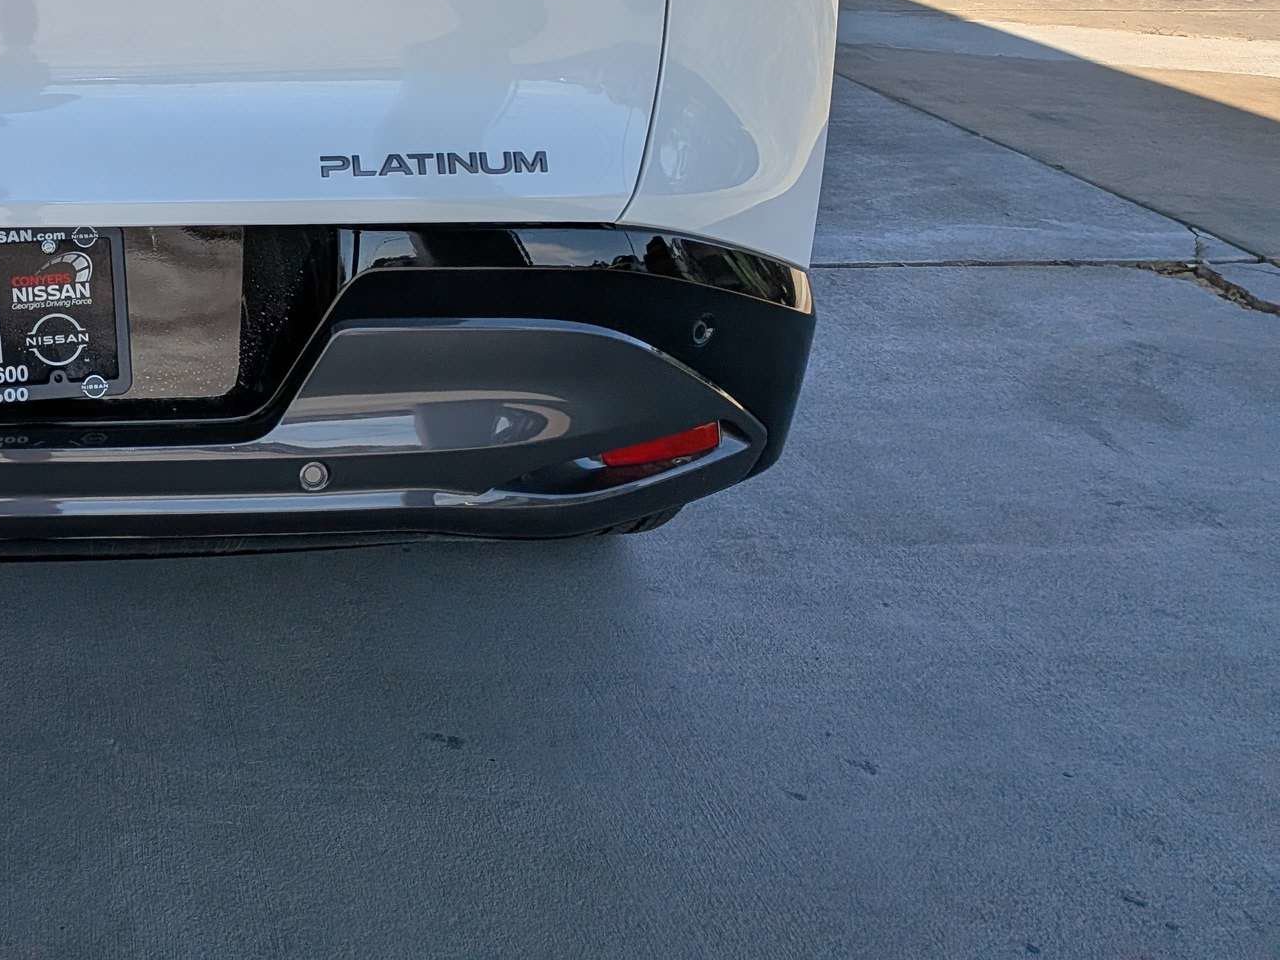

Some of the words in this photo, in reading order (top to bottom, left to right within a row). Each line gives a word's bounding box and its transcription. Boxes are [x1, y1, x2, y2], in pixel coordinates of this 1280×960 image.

[320, 151, 549, 178] PLATINUM
[10, 272, 72, 287] CONYERS
[12, 282, 91, 303] NISSAN
[46, 299, 71, 308] Driving
[71, 297, 93, 306] Force
[25, 333, 89, 346] NISSAN
